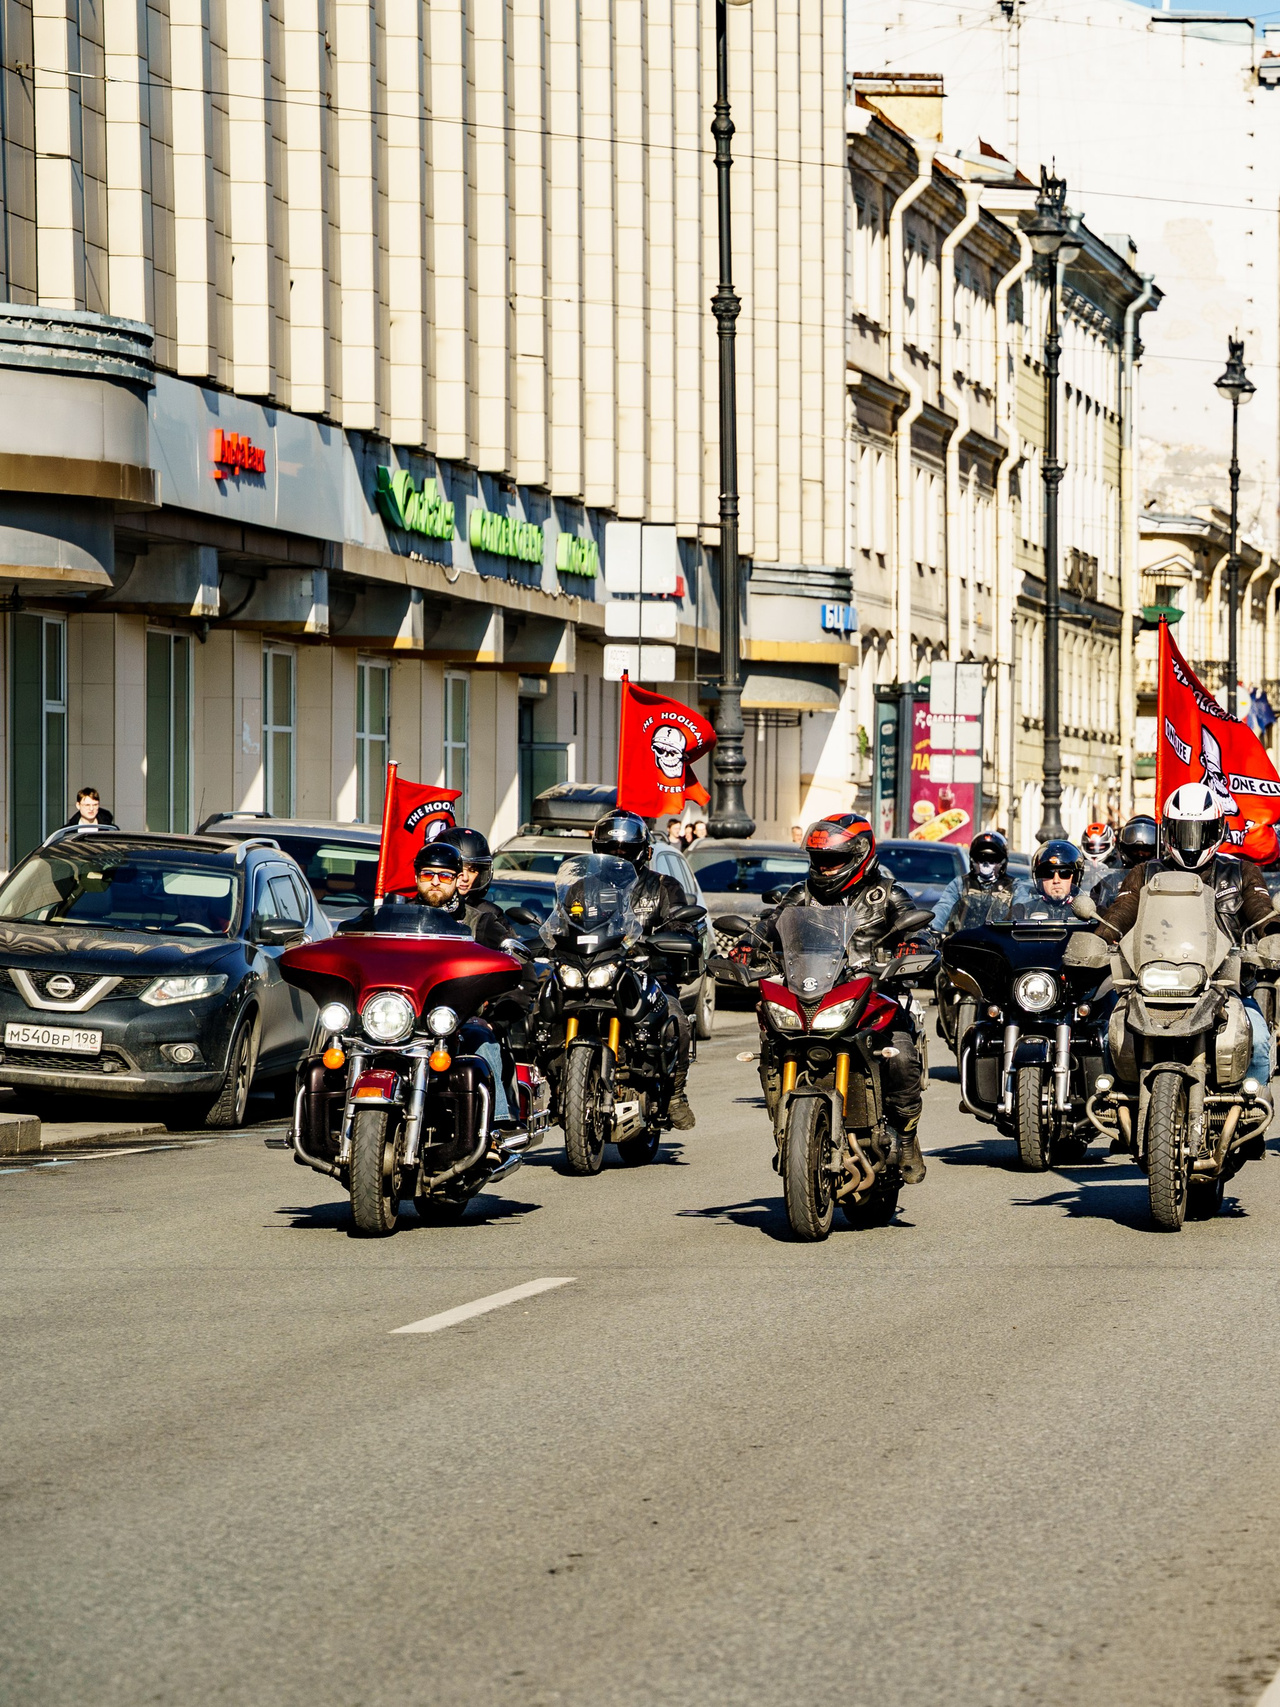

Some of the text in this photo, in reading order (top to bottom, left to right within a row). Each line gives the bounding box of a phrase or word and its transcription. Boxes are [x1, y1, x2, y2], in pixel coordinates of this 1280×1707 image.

[1231, 777, 1257, 793] ONE
[407, 808, 425, 827] THE
[75, 1032, 97, 1045] 198
